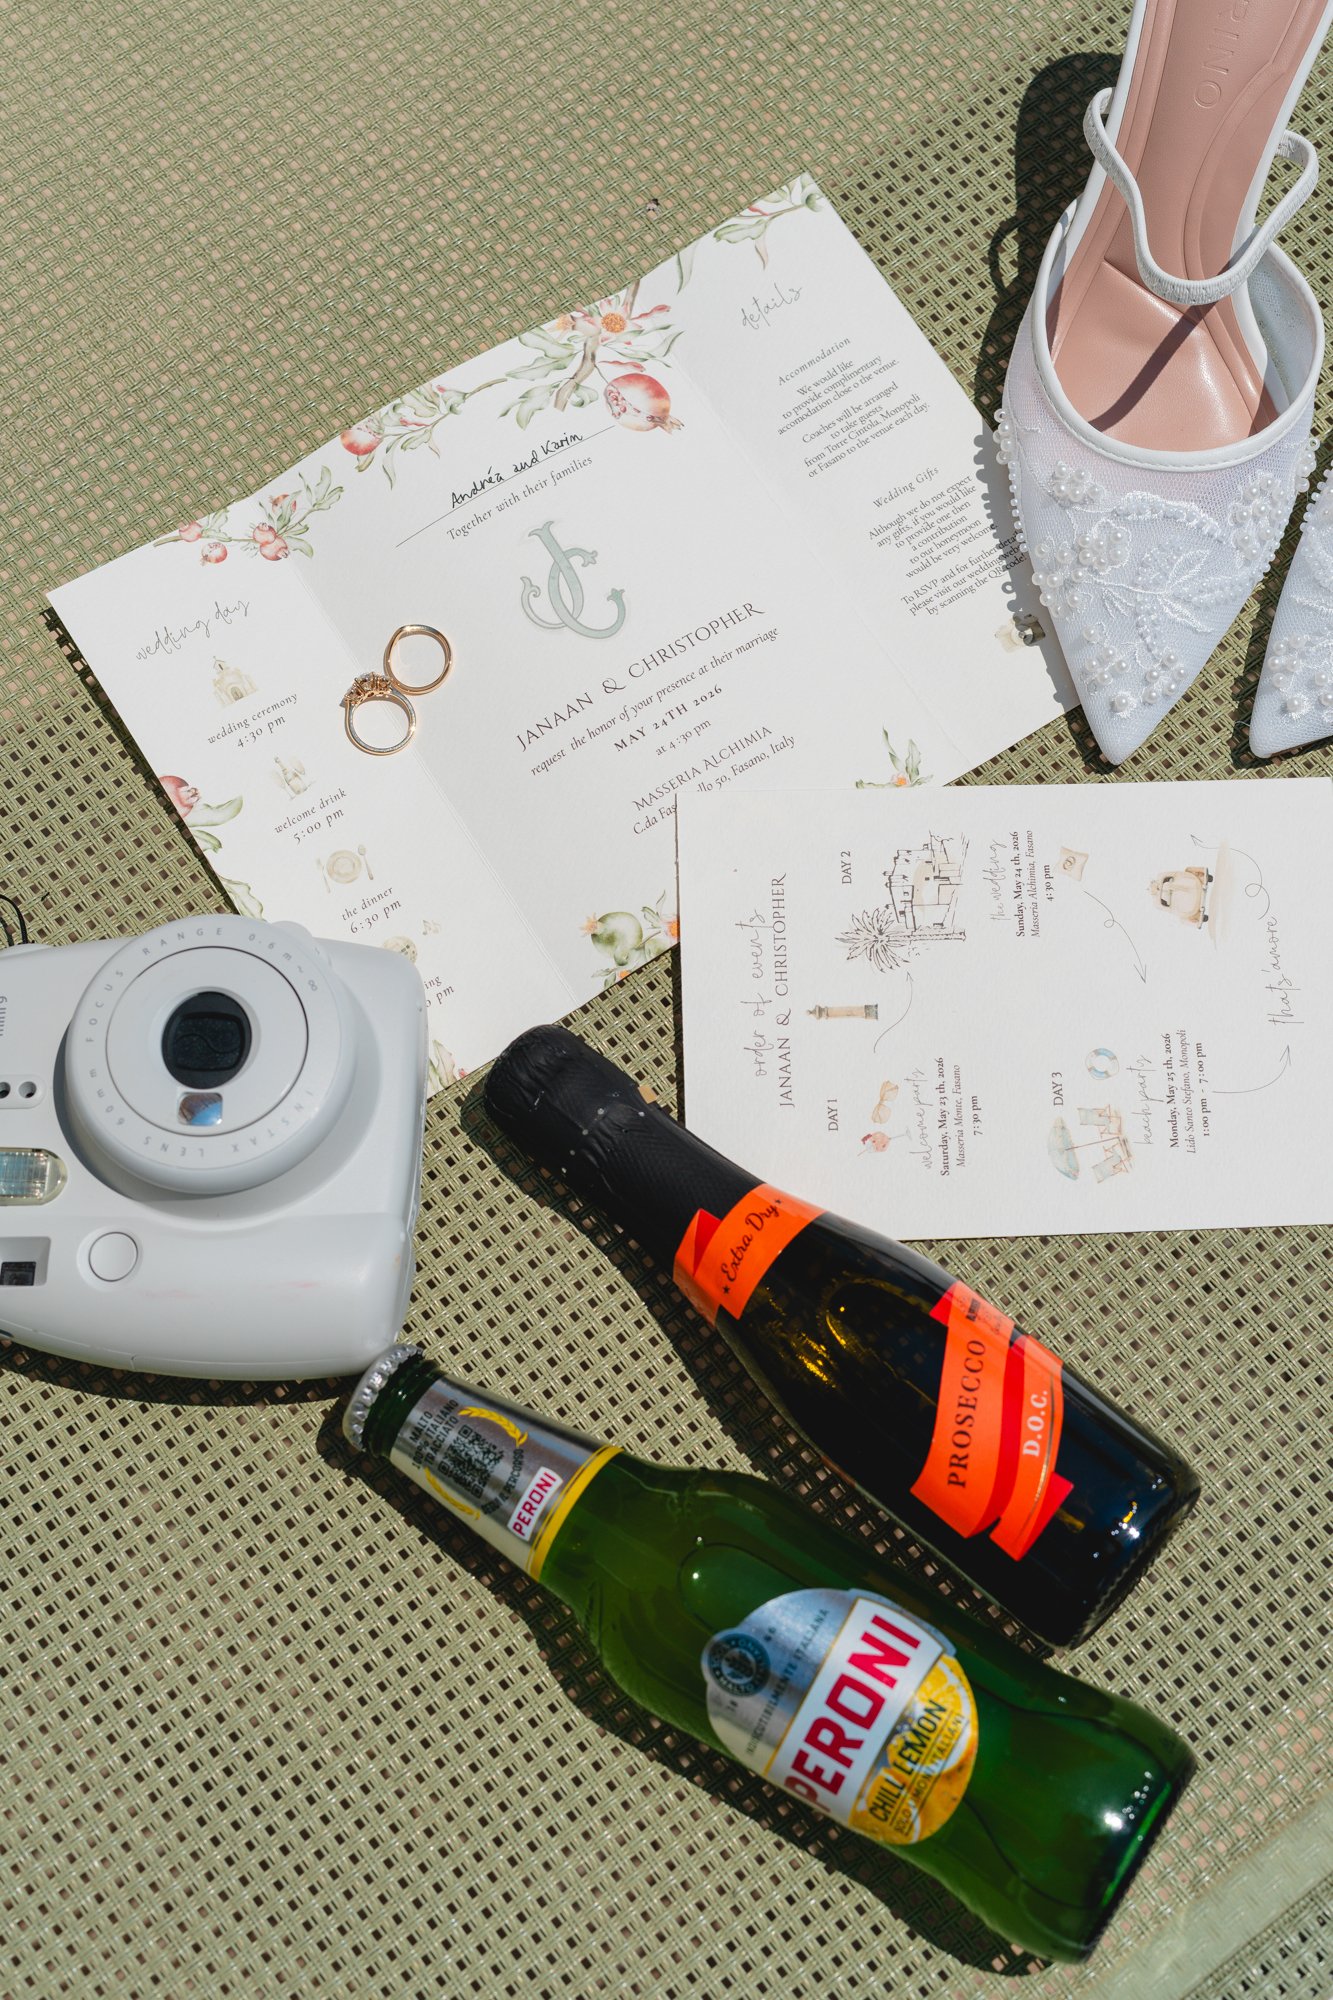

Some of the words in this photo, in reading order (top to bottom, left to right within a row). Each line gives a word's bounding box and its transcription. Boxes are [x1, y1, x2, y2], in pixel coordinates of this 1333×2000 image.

[740, 282, 802, 329] details
[778, 338, 850, 386] Accommodation
[796, 385, 812, 395] We
[812, 367, 838, 387] would
[836, 360, 853, 372] like
[777, 398, 832, 435] accomodation
[872, 359, 899, 375] venue.
[792, 391, 822, 415] provide
[823, 355, 881, 394] complimentary
[802, 420, 836, 442] Coaches
[863, 380, 898, 407] arranged
[840, 419, 857, 433] take
[858, 405, 883, 424] guests
[803, 452, 825, 467] from
[823, 438, 848, 453] Torre
[847, 419, 882, 439] Cintola,
[879, 393, 920, 421] Monopoli
[817, 452, 846, 471] Fasano
[869, 423, 894, 439] venue
[913, 402, 929, 414] day.
[512, 449, 540, 472] and
[540, 432, 583, 455] Karin
[446, 509, 491, 539] Together
[495, 492, 520, 512] with
[522, 479, 547, 497] their
[550, 456, 592, 486] families
[872, 482, 915, 507] Wedding
[915, 467, 938, 483] Gifts
[869, 513, 906, 540] Although
[946, 475, 972, 497] expect
[892, 524, 913, 540] gifts,
[935, 489, 965, 511] would
[904, 521, 936, 545] provide
[951, 501, 971, 515] then
[917, 515, 967, 547] contribution
[932, 519, 981, 549] honeymoon
[905, 558, 932, 577] would
[900, 595, 914, 604] To
[912, 578, 937, 598] RSVP
[908, 596, 934, 616] please
[939, 584, 976, 608] scanning
[135, 619, 210, 660] wedding
[214, 600, 249, 624] day
[516, 691, 593, 752] JANAAN
[601, 678, 625, 693] &
[628, 602, 764, 677] CHRISTOPHER
[207, 718, 250, 743] wedding
[251, 693, 296, 720] ceremony
[530, 749, 566, 775] request
[570, 736, 586, 750] the
[585, 716, 615, 739] honor
[630, 695, 653, 717] your
[656, 671, 696, 702] presence
[710, 651, 732, 668] their
[735, 628, 778, 654] marriage
[613, 726, 645, 751] MAY
[652, 703, 687, 729] 24TH
[693, 685, 721, 706] 2026
[237, 727, 262, 747] 4:30
[267, 716, 285, 733] pm
[669, 730, 692, 748] 4:30
[693, 720, 711, 736] pm
[274, 806, 316, 833] welcome
[319, 787, 346, 809] drink
[293, 821, 321, 843] 5:00
[325, 809, 343, 827] pm
[1009, 831, 1019, 850] 2026
[1024, 830, 1034, 857] Fasano
[840, 860, 851, 884] DAY
[982, 840, 1007, 900] wedding
[1010, 853, 1020, 865] th,
[1014, 868, 1022, 877] 24
[1043, 864, 1053, 879] pm
[1012, 880, 1024, 899] May
[1026, 860, 1037, 899] Alchimia,
[1044, 881, 1054, 901] 4:30
[341, 907, 358, 920] the
[361, 887, 392, 910] dinner
[350, 913, 378, 933] 6:30
[383, 900, 401, 919] pm
[1013, 902, 1026, 936] Sunday,
[1029, 901, 1040, 937] Masseria
[734, 909, 771, 978] events
[771, 872, 788, 996] CHRISTOPHER
[86, 970, 124, 1043] FOCUS
[142, 927, 223, 956] RANGE
[435, 985, 454, 1004] pm
[740, 992, 772, 1016] of
[775, 1008, 791, 1025] &
[743, 1029, 774, 1076] order
[1161, 1033, 1171, 1053] 2026
[1176, 1029, 1190, 1068] Monopoli
[1195, 1042, 1206, 1057] pm
[776, 1038, 795, 1107] JANAAN
[934, 1057, 944, 1078] 2026
[951, 1064, 961, 1094] Fasano
[1125, 1055, 1164, 1102] party
[1163, 1056, 1173, 1069] th,
[1166, 1071, 1175, 1081] 25
[1197, 1060, 1208, 1083] 7:00
[90, 1069, 126, 1126] 60mm
[903, 1069, 933, 1106] party
[935, 1080, 945, 1093] th,
[939, 1096, 948, 1105] 23
[971, 1095, 981, 1110] pm
[1051, 1081, 1063, 1105] DAY
[1165, 1084, 1177, 1104] May
[1180, 1071, 1193, 1104] Stefano,
[232, 1090, 313, 1152] INSTAX
[829, 1107, 838, 1130] DAY
[937, 1108, 949, 1128] May
[953, 1097, 963, 1126] Monte,
[1184, 1106, 1194, 1131] Santo
[1200, 1098, 1211, 1113] pm
[909, 1107, 932, 1169] welcome
[972, 1113, 982, 1135] 7:30
[1131, 1106, 1153, 1144] beach
[1167, 1107, 1179, 1147] Monday,
[144, 1136, 204, 1157] LENS
[938, 1131, 951, 1175] Saturday,
[954, 1129, 965, 1167] Masseria
[1184, 1134, 1196, 1153] Lido
[720, 1235, 752, 1282] Extra
[744, 1205, 779, 1231] Dry
[409, 1411, 432, 1442] MALTO
[946, 1340, 984, 1488] PROSECCO
[1022, 1390, 1047, 1456] D.O.C.
[423, 1416, 458, 1465] TRACCIATO
[512, 1472, 555, 1534] PERONI
[786, 1614, 921, 1814] PERONI
[869, 1777, 906, 1822] CHILL
[893, 1698, 947, 1776] LEMON
